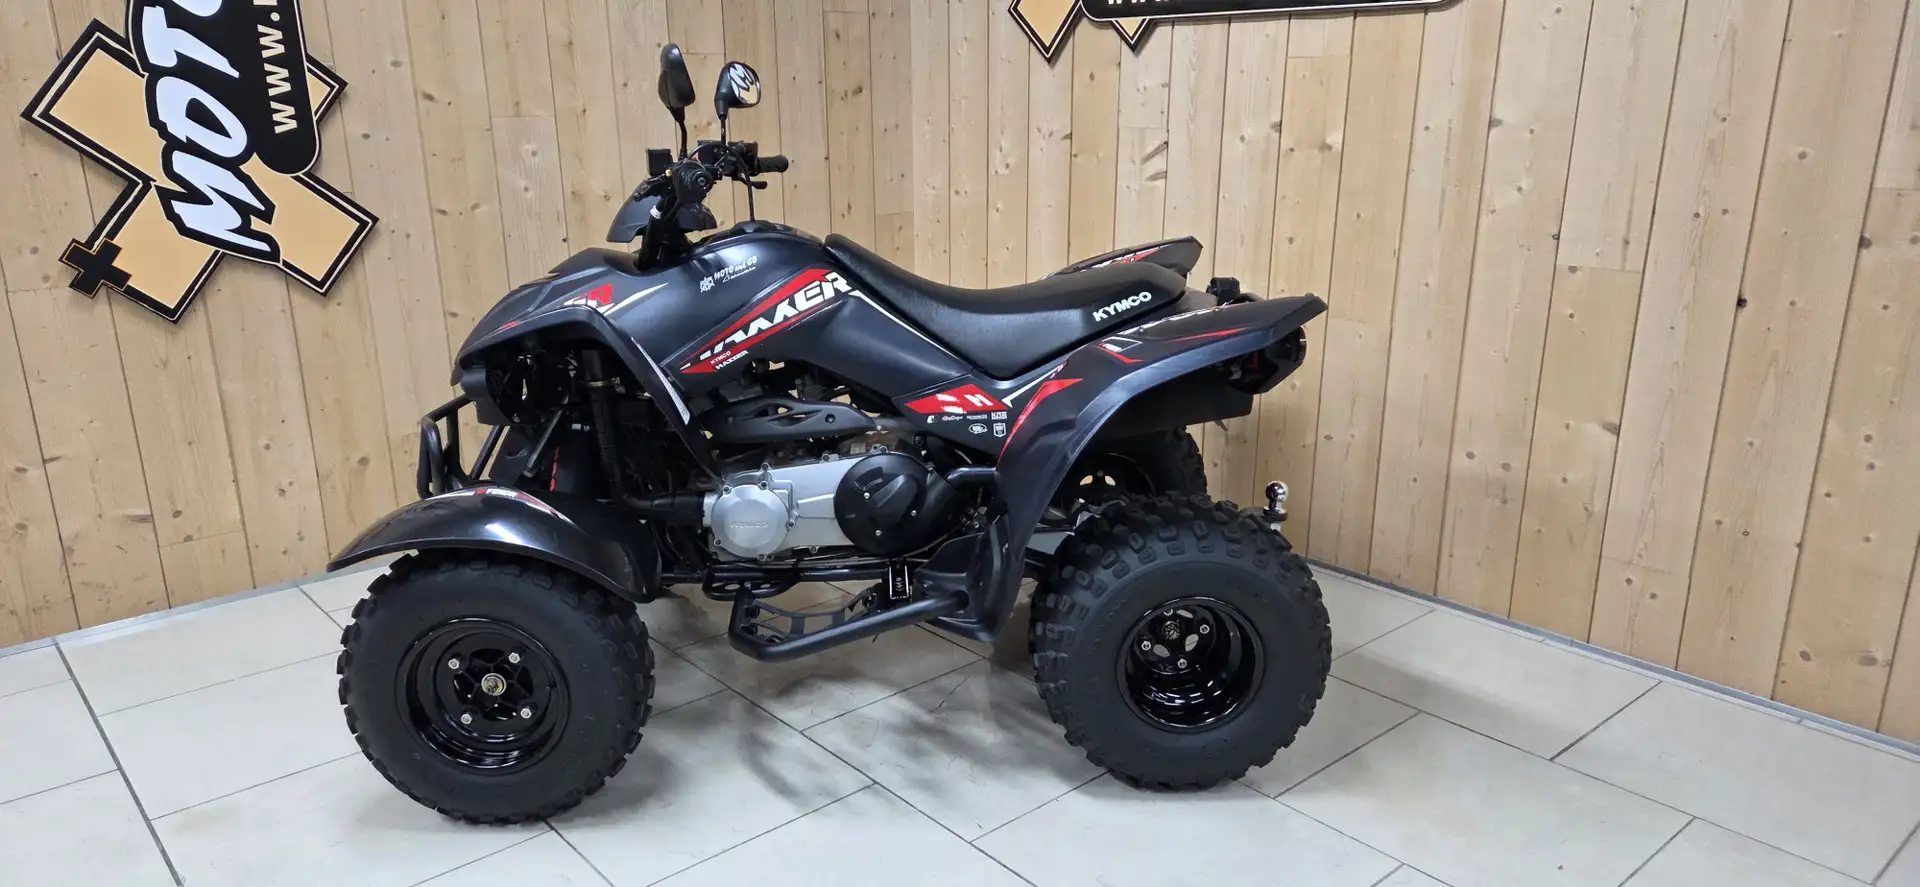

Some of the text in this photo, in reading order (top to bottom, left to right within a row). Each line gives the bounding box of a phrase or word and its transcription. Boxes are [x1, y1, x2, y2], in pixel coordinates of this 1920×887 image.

[253, 0, 298, 134] www.
[142, 0, 276, 253] MOT
[713, 265, 735, 281] MOTO
[1092, 291, 1152, 322] KYMCO
